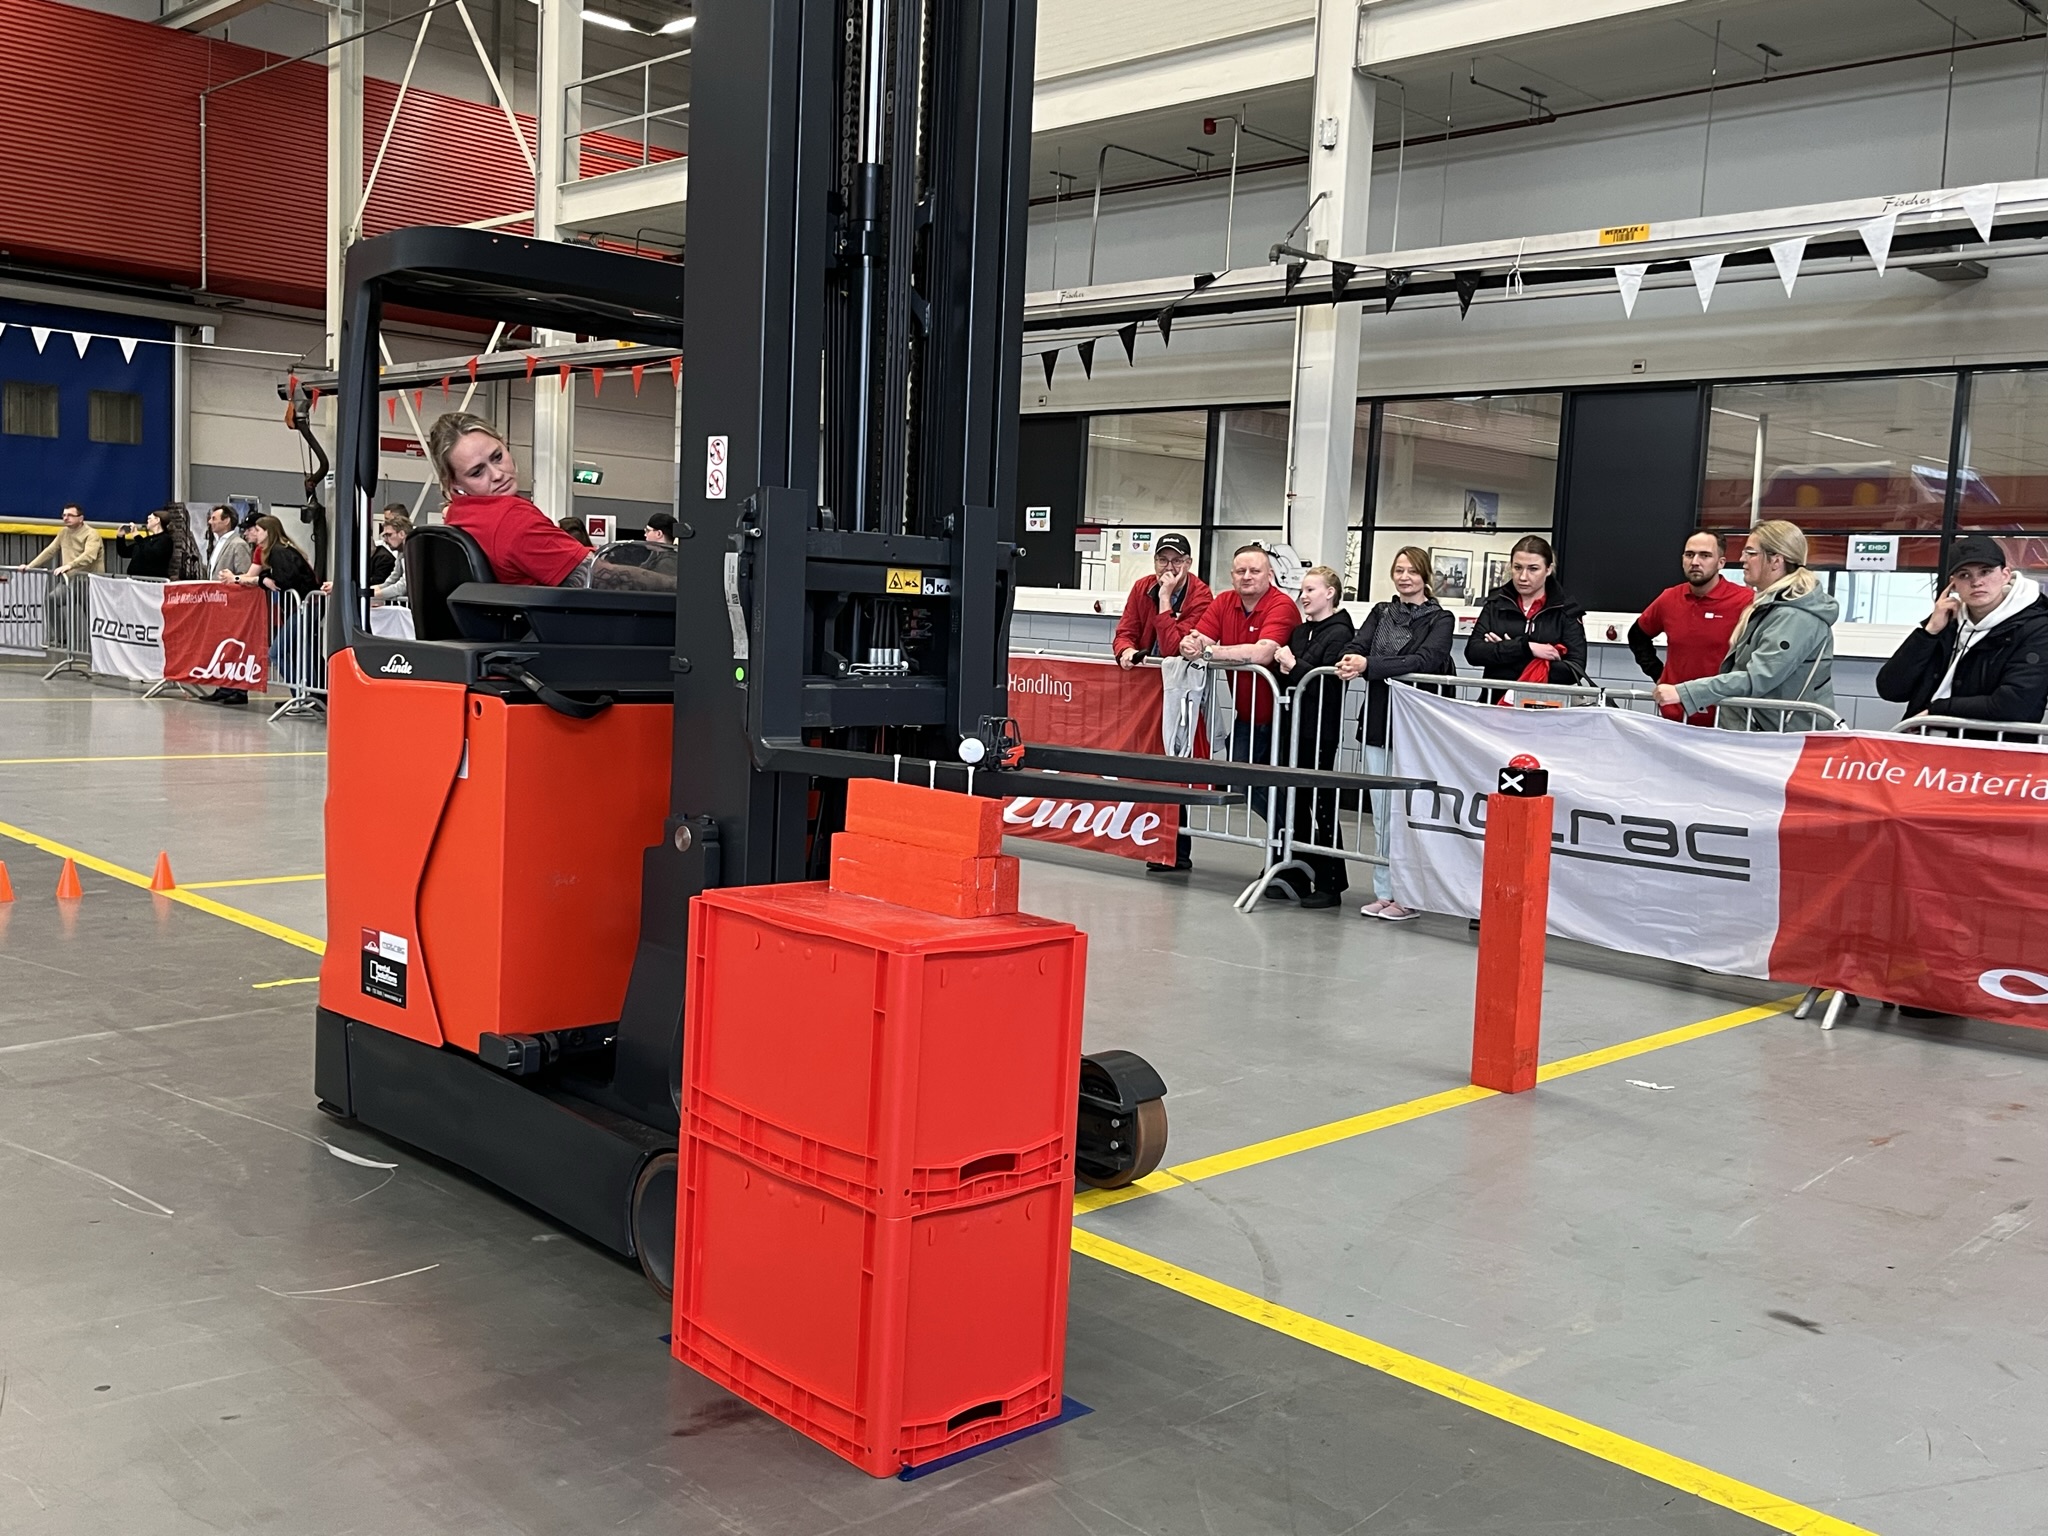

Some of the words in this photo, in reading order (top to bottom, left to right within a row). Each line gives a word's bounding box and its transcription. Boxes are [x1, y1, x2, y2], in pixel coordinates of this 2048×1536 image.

[1882, 194, 1930, 213] Fischer
[1605, 226, 1639, 235] WERKPLEK
[189, 638, 262, 684] Linde
[380, 653, 413, 675] Linde
[1007, 673, 1073, 703] Handling
[1821, 755, 1906, 785] Linde
